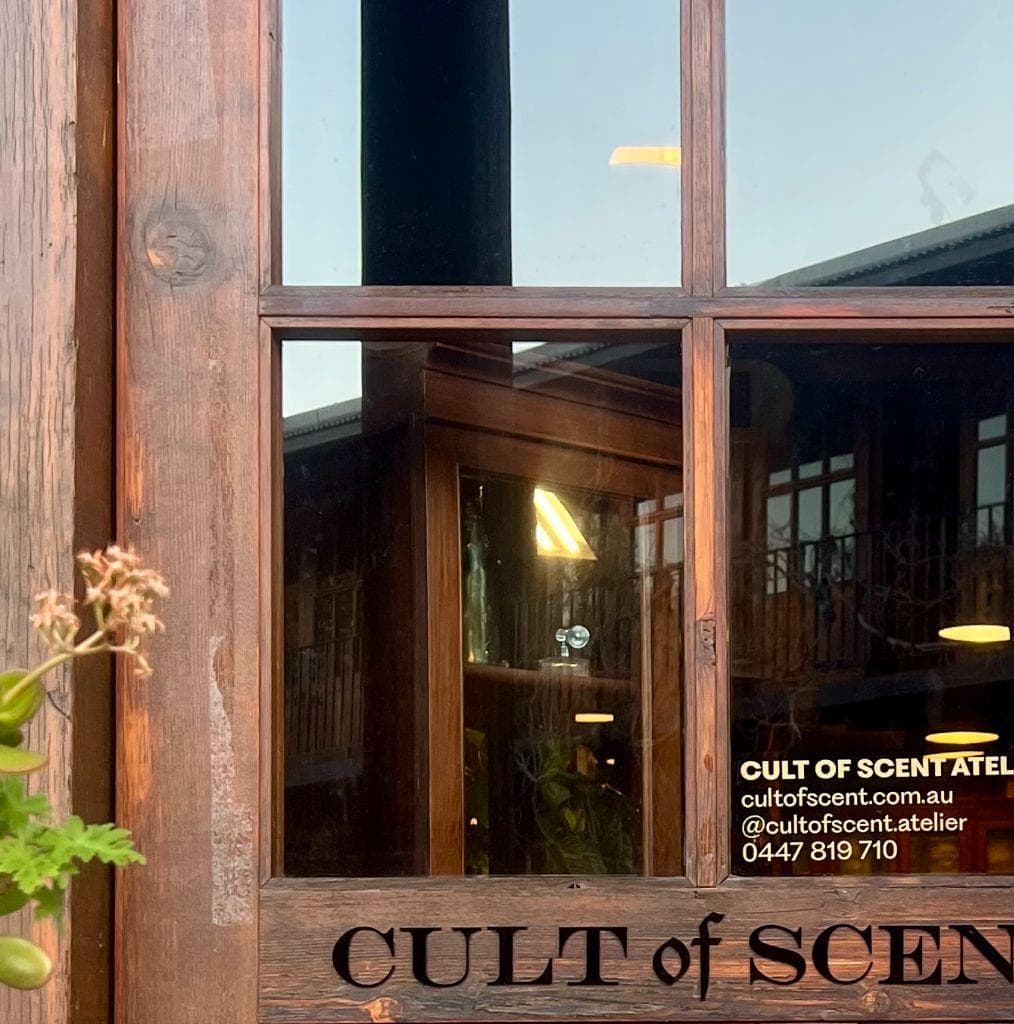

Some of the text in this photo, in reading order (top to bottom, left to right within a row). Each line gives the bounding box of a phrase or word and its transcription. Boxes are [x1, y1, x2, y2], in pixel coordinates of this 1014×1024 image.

[740, 760, 810, 781] CULT
[814, 759, 852, 780] OF
[857, 757, 947, 779] SCENT
[741, 787, 953, 808] cultofscent.com.au
[741, 812, 968, 839] @cultofscent.atelier
[742, 839, 898, 862] 0447 819 710
[332, 926, 628, 988] CULT
[652, 911, 725, 1001] of
